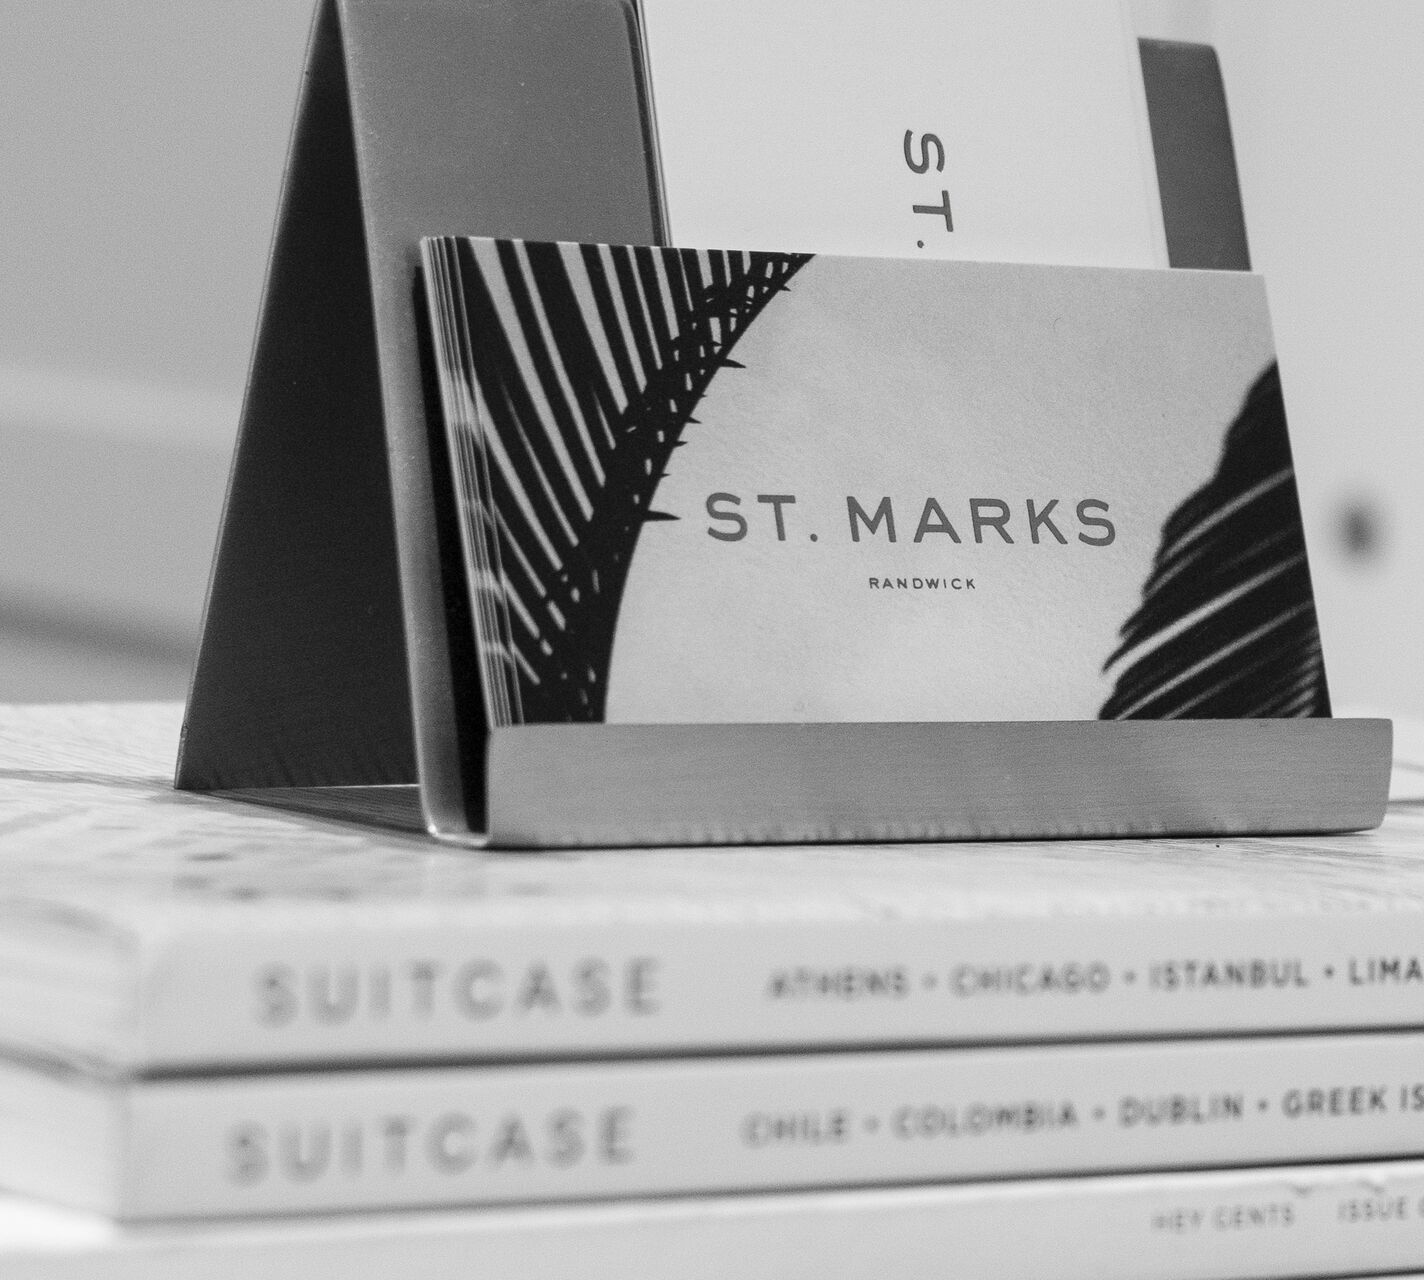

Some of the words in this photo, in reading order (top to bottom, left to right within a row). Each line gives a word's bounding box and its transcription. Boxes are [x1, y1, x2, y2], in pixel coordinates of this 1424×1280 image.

[902, 128, 955, 249] ST.
[704, 490, 819, 543] ST.
[845, 494, 1118, 548] MARKS
[868, 576, 976, 591] RANDWICK
[256, 957, 659, 1028] SUITCASE
[767, 967, 909, 1001] ATHENS
[950, 961, 1111, 998] CHICAGO
[1150, 958, 1309, 991] ISTANBUL
[1348, 957, 1424, 986] LIMA
[227, 1105, 635, 1188] SUITCASE
[742, 1109, 849, 1148] CHILE
[894, 1101, 1078, 1138] COLOMBIA
[1119, 1094, 1244, 1128] DUBLIN
[1281, 1085, 1387, 1119] GREEK
[1150, 1208, 1205, 1236] HEY
[1212, 1203, 1296, 1231] CENTS
[1338, 1198, 1409, 1223] ISSUE
